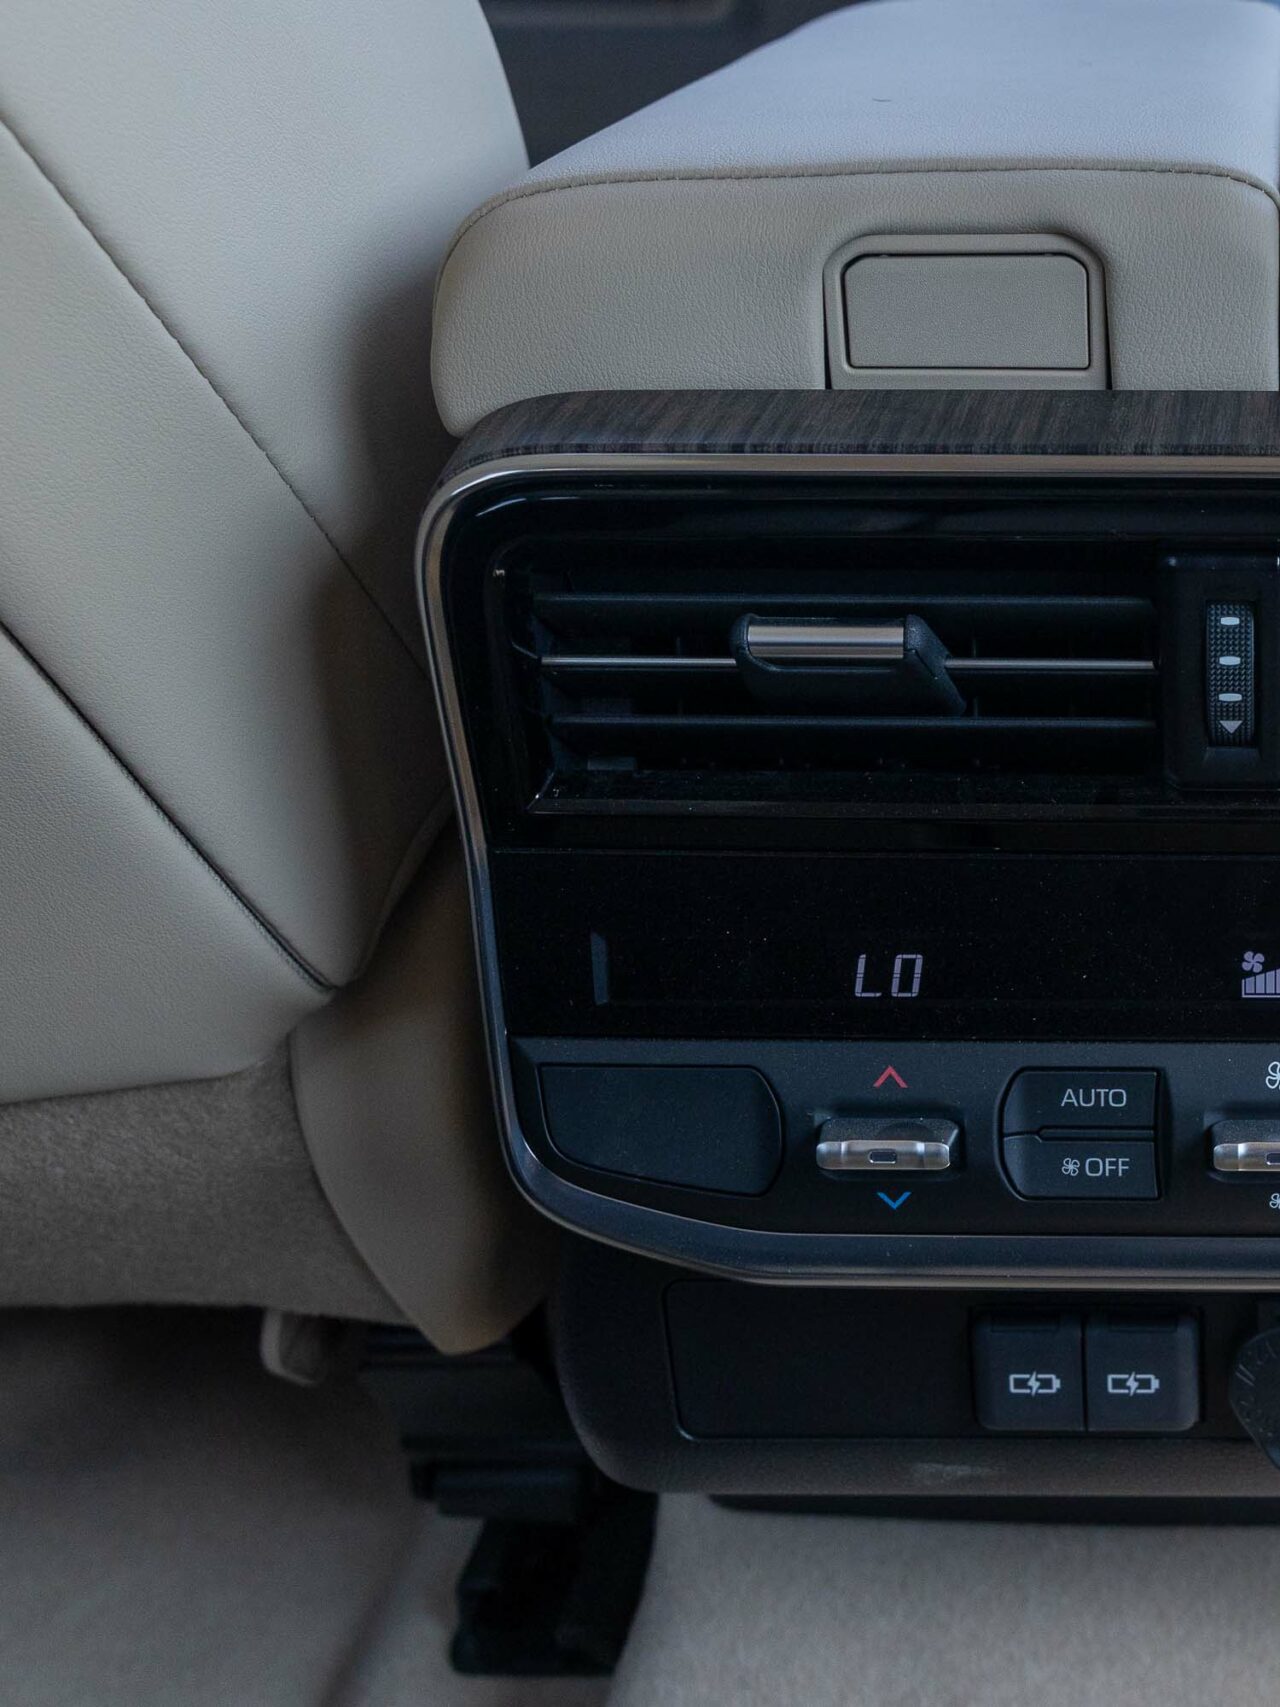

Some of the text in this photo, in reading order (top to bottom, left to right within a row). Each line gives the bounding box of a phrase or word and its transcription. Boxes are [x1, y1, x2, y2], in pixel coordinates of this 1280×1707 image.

[855, 954, 923, 997] LO
[1060, 1088, 1127, 1108] AUTO
[1084, 1157, 1130, 1177] OFF
